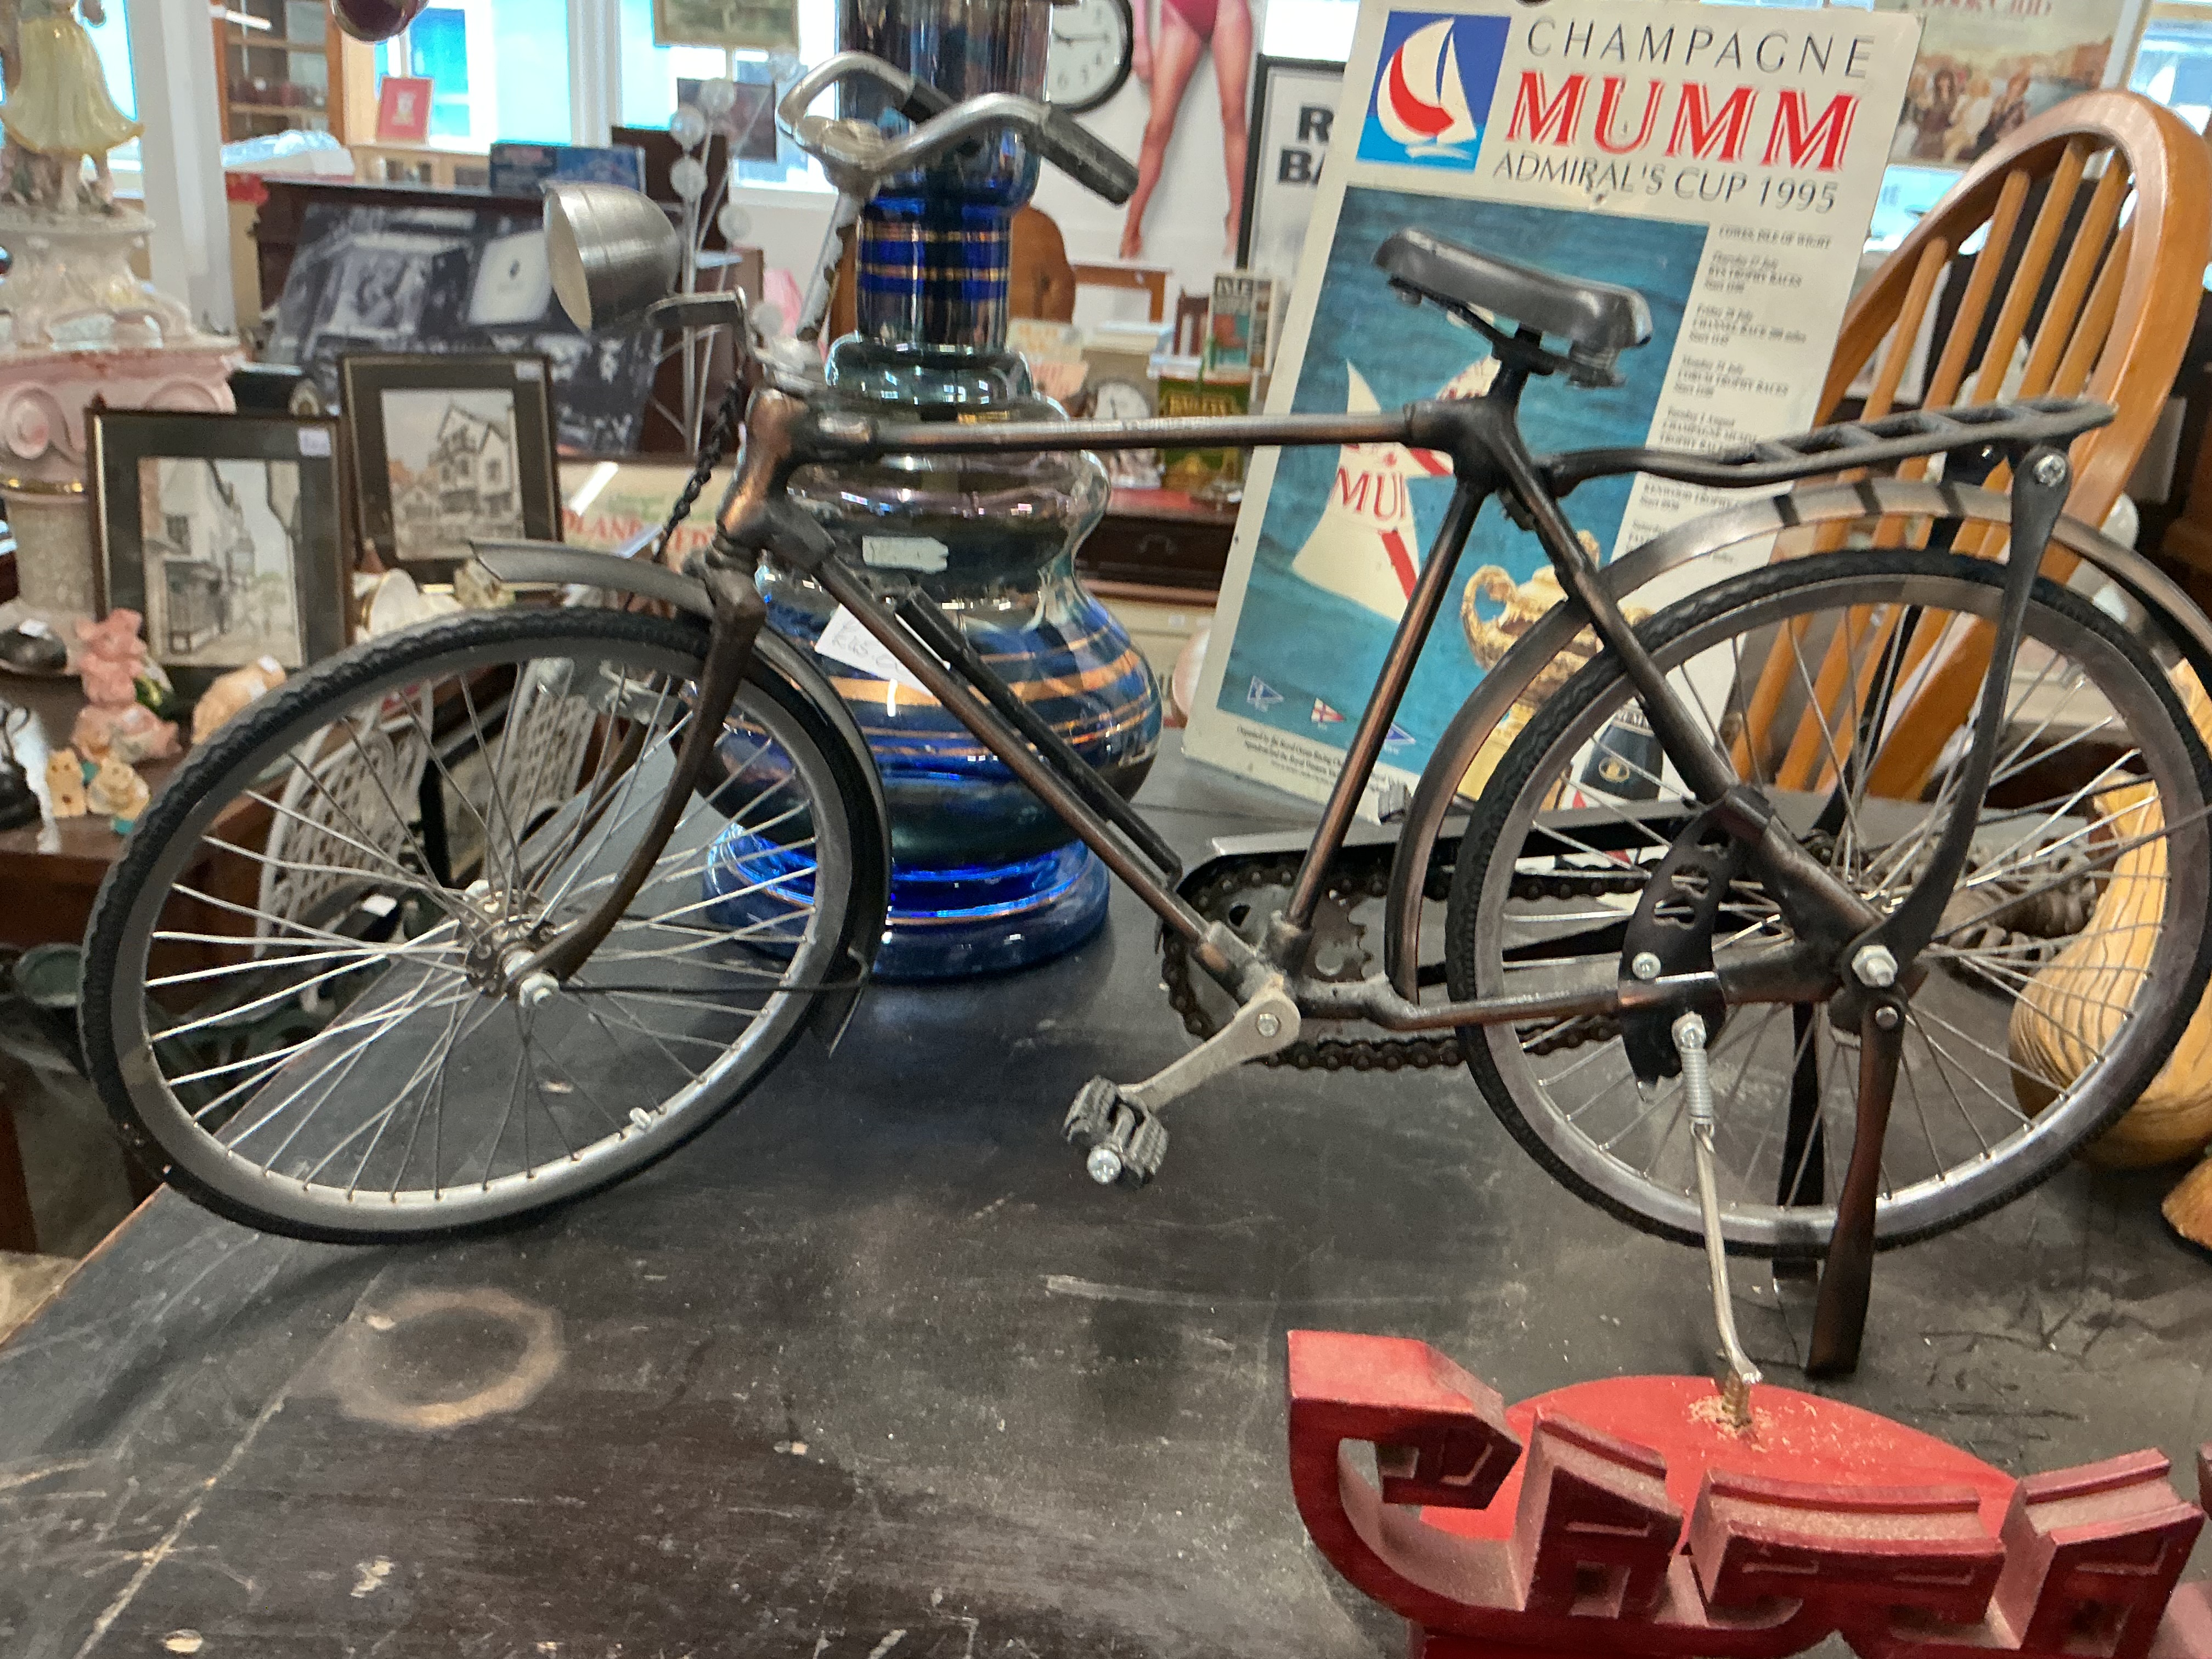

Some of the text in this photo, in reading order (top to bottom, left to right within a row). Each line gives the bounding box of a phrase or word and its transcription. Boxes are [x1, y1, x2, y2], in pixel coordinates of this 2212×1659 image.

[1527, 16, 1875, 79] CHAMPAGNE
[1505, 69, 1863, 173] MUMM
[1491, 150, 1838, 215] ADMIRAL'S CUP 1995
